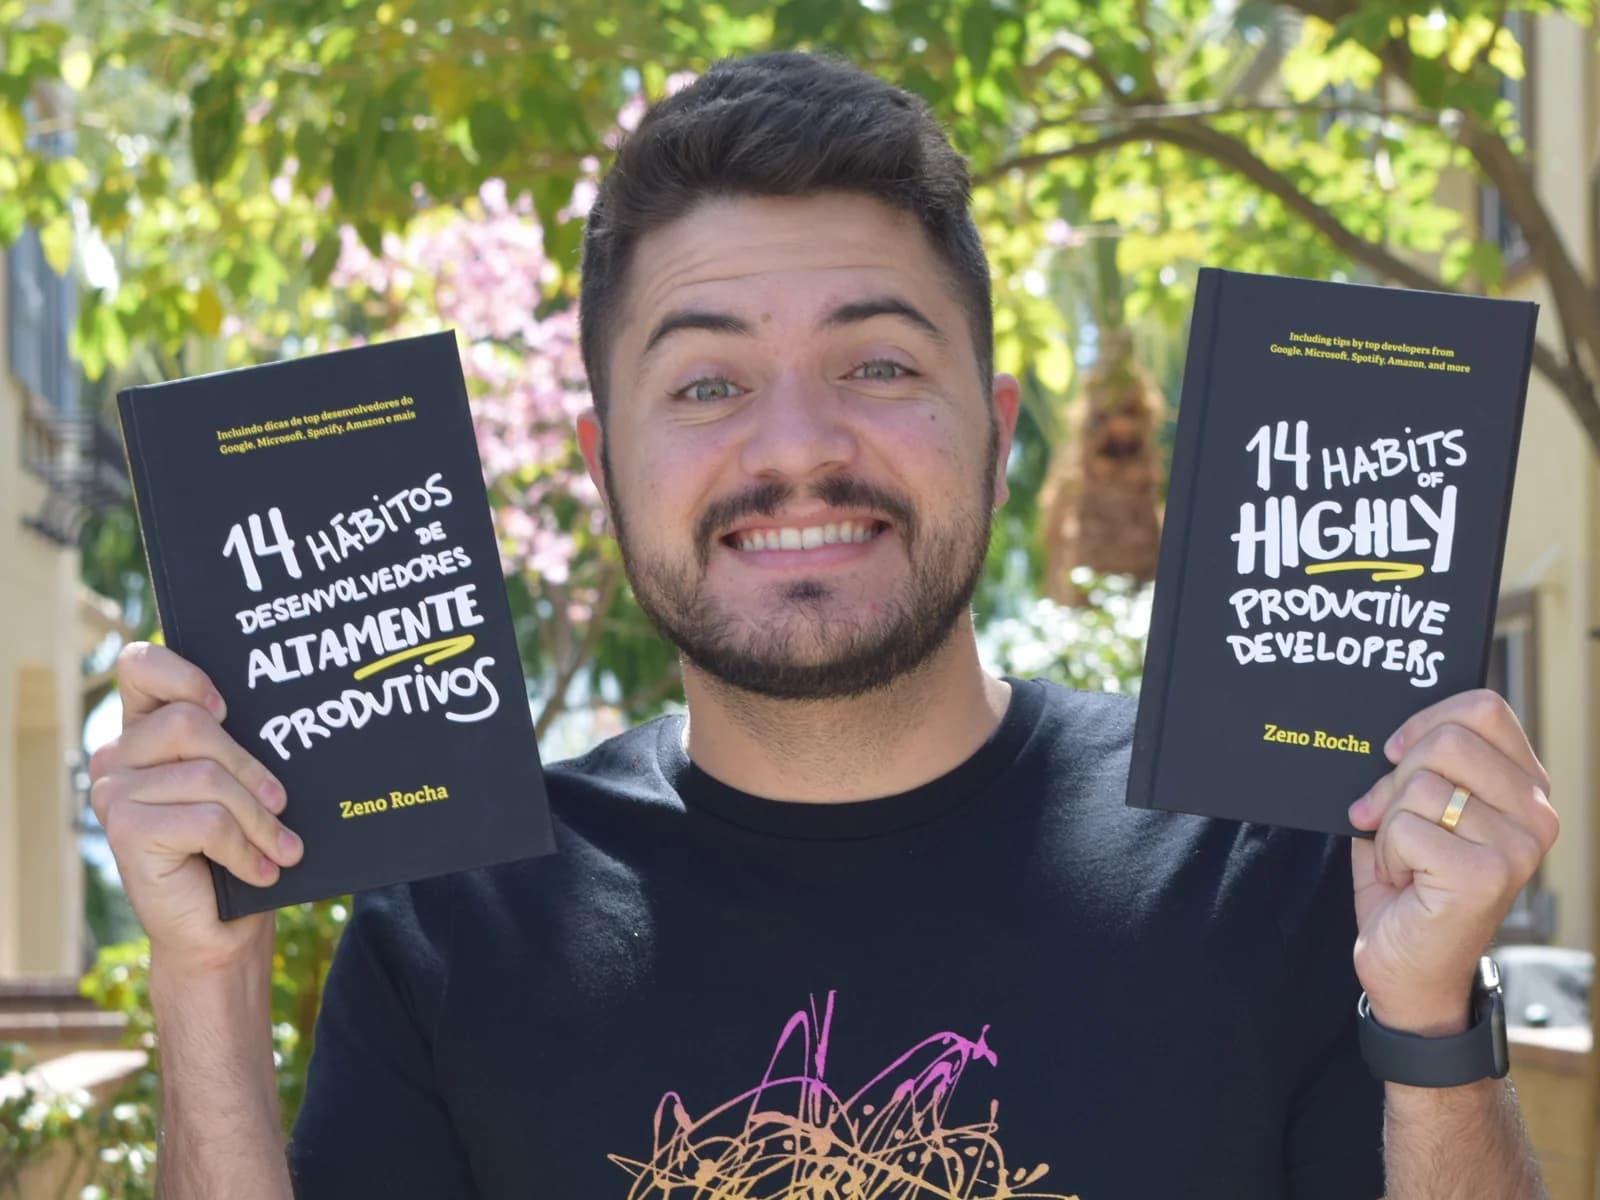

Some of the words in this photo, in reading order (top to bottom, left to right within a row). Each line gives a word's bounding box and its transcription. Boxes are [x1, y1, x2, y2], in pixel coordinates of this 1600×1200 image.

[1270, 343, 1303, 357] Google,
[1304, 347, 1350, 361] Microsoft,
[1351, 352, 1386, 367] Spotify,
[1387, 356, 1427, 369] Amazon,
[1428, 360, 1446, 371] and
[1446, 363, 1471, 374] more
[1289, 331, 1332, 347] Including
[1333, 336, 1351, 348] tips
[1352, 337, 1364, 350] by
[1365, 340, 1380, 352] top
[1381, 342, 1431, 356] developers
[1431, 346, 1455, 358] from
[216, 423, 263, 441] Incluindo
[264, 419, 290, 432] dicas
[290, 416, 303, 427] de
[303, 413, 321, 425] top
[321, 399, 400, 421] desenvolvedores
[400, 395, 414, 407] do
[219, 440, 257, 455] Google,
[256, 430, 307, 448] Microsoft,
[307, 423, 345, 440] Spotify,
[346, 416, 385, 431] Amazon
[386, 415, 393, 424] e
[393, 409, 417, 423] mais
[1246, 420, 1311, 491] 14
[1417, 471, 1445, 488] OF
[222, 506, 303, 592] 14
[414, 520, 447, 546] DE
[1230, 485, 1458, 579] HIGHLY
[235, 546, 472, 635] DESENVOLVEDORES
[247, 583, 485, 690] ALTAMENTE
[1226, 631, 1445, 688] DEVELOPERS
[1263, 723, 1310, 746] Zeno
[1313, 730, 1371, 755] Rocha
[339, 798, 387, 819] Zeno
[389, 784, 449, 809] Rocha
